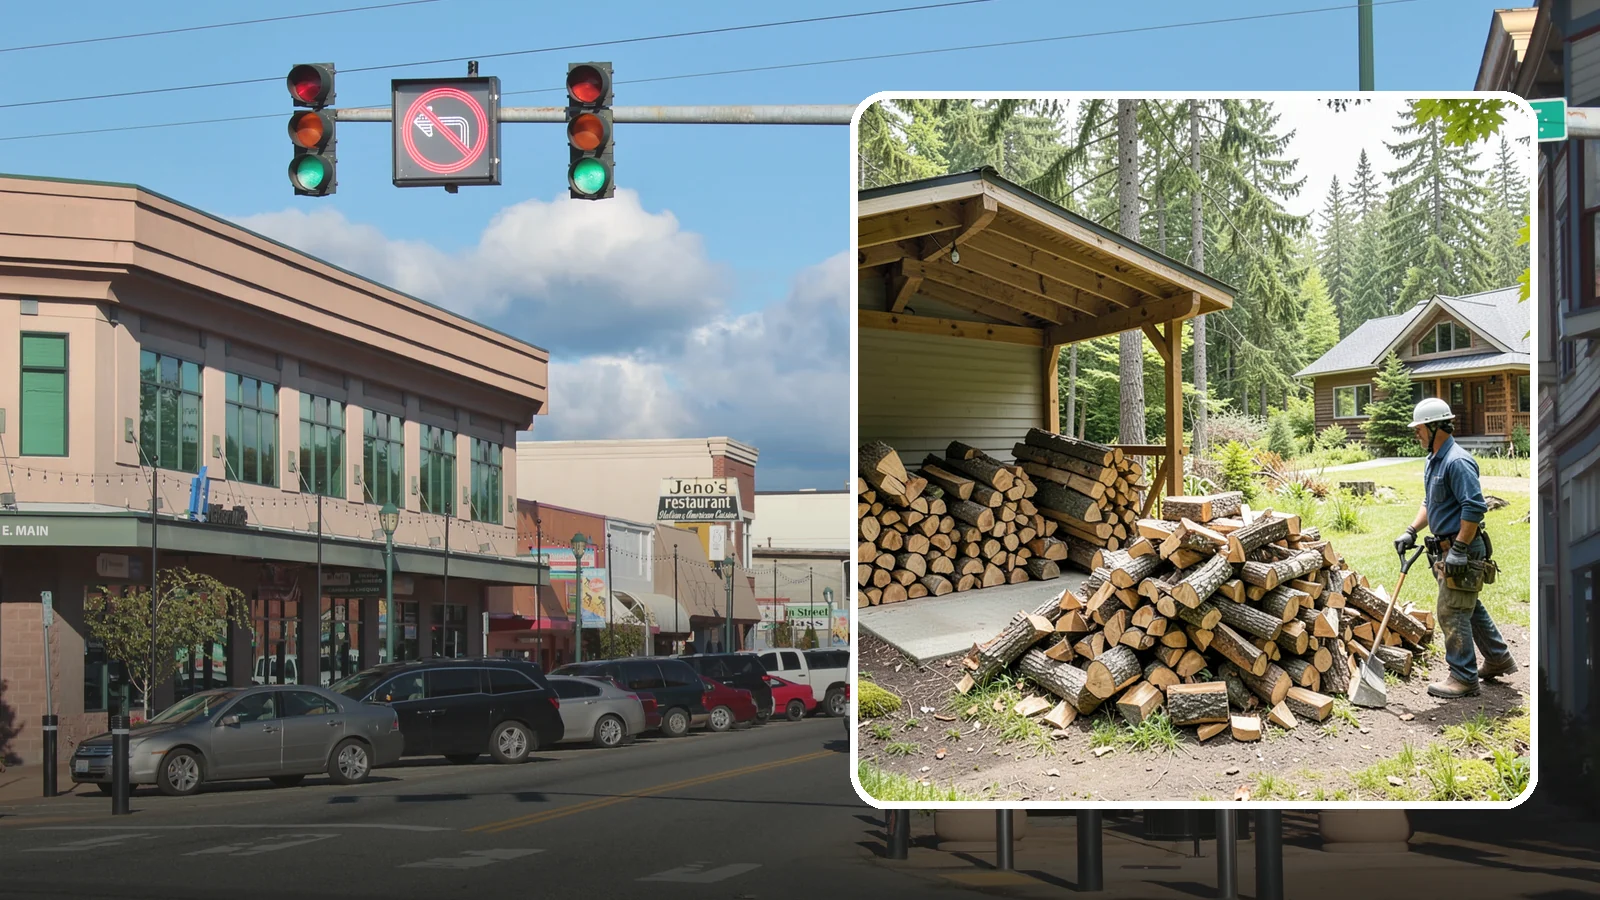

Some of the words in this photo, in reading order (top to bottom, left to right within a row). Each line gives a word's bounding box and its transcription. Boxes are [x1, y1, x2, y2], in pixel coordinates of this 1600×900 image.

[670, 480, 727, 494] Jeno's
[665, 496, 731, 509] restaurant
[658, 510, 681, 519] Italian
[686, 510, 714, 519] American
[715, 510, 737, 519] Cuisine
[2, 525, 13, 536] E.
[15, 525, 49, 536] MAIN
[797, 607, 828, 616] Street
[790, 619, 824, 627] lass
